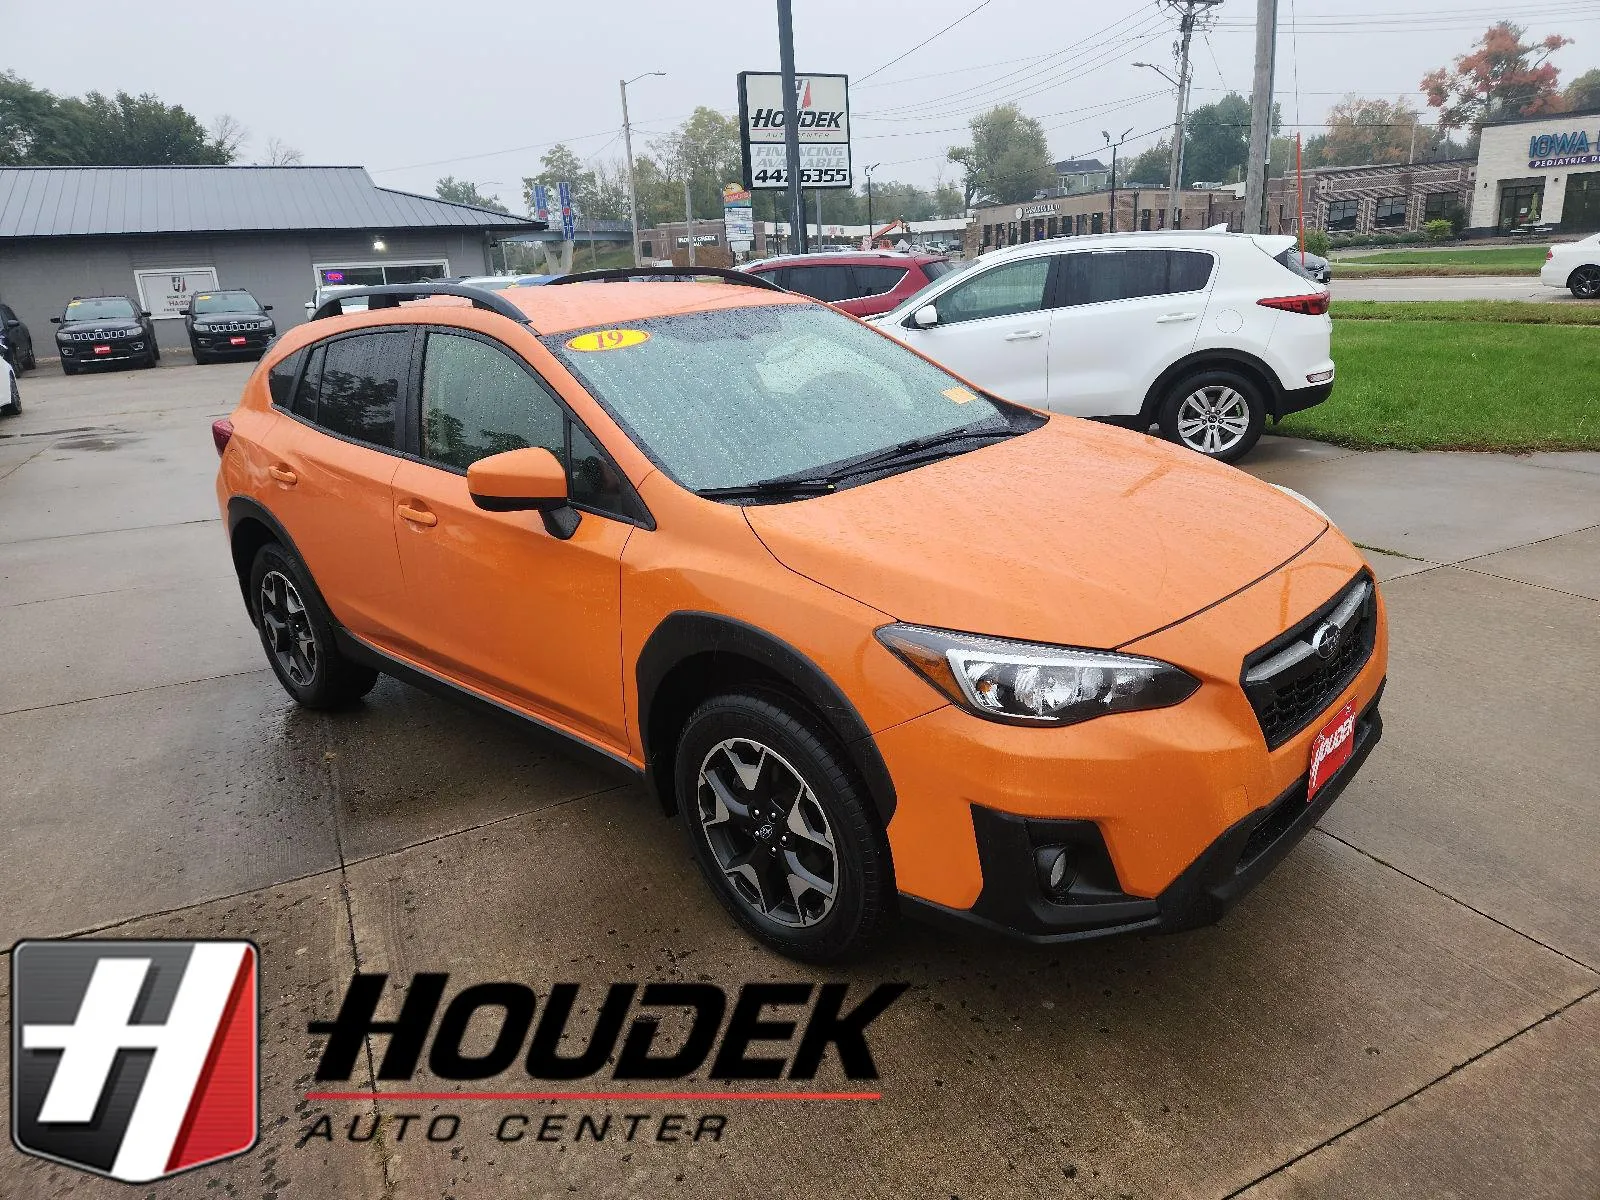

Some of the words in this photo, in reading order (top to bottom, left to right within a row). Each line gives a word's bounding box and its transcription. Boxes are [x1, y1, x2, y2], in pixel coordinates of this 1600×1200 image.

[751, 109, 845, 128] HODEK
[1529, 131, 1589, 158] IOWA
[756, 157, 845, 168] AVAABLE
[1534, 156, 1587, 168] PEDIATRIC
[594, 330, 624, 350] 19
